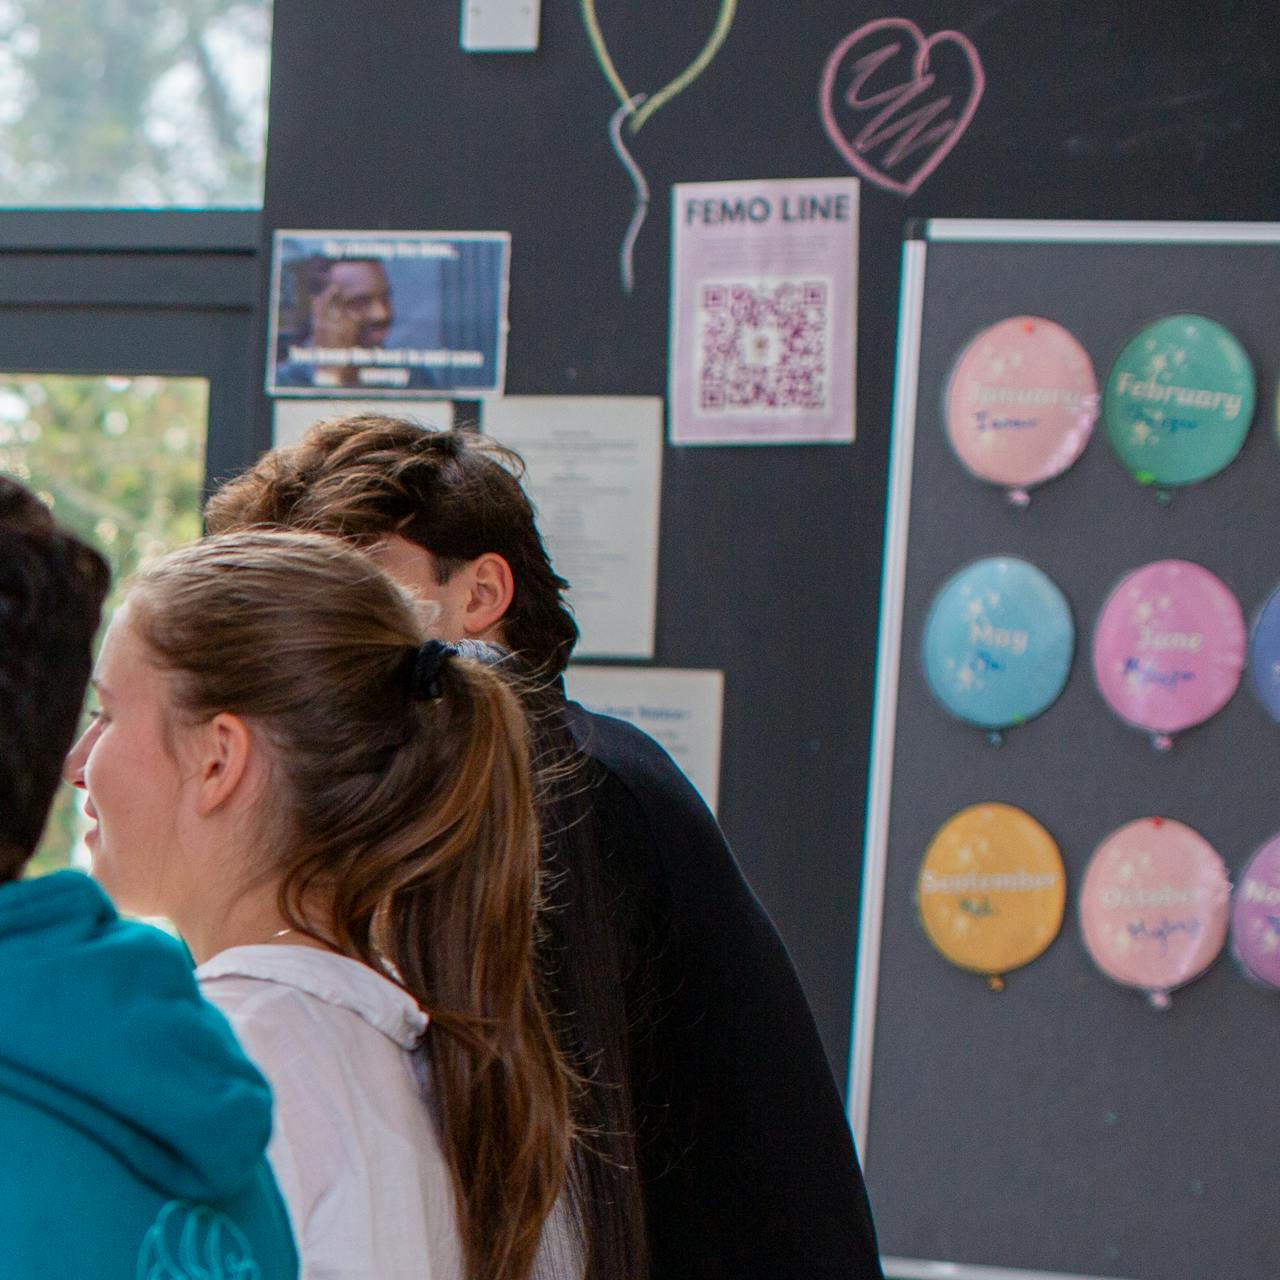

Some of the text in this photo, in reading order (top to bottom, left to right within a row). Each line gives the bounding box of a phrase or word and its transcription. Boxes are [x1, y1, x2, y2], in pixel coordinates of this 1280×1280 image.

[686, 194, 851, 224] FEMO LINE
[1117, 371, 1242, 420] February
[969, 622, 1028, 655] May
